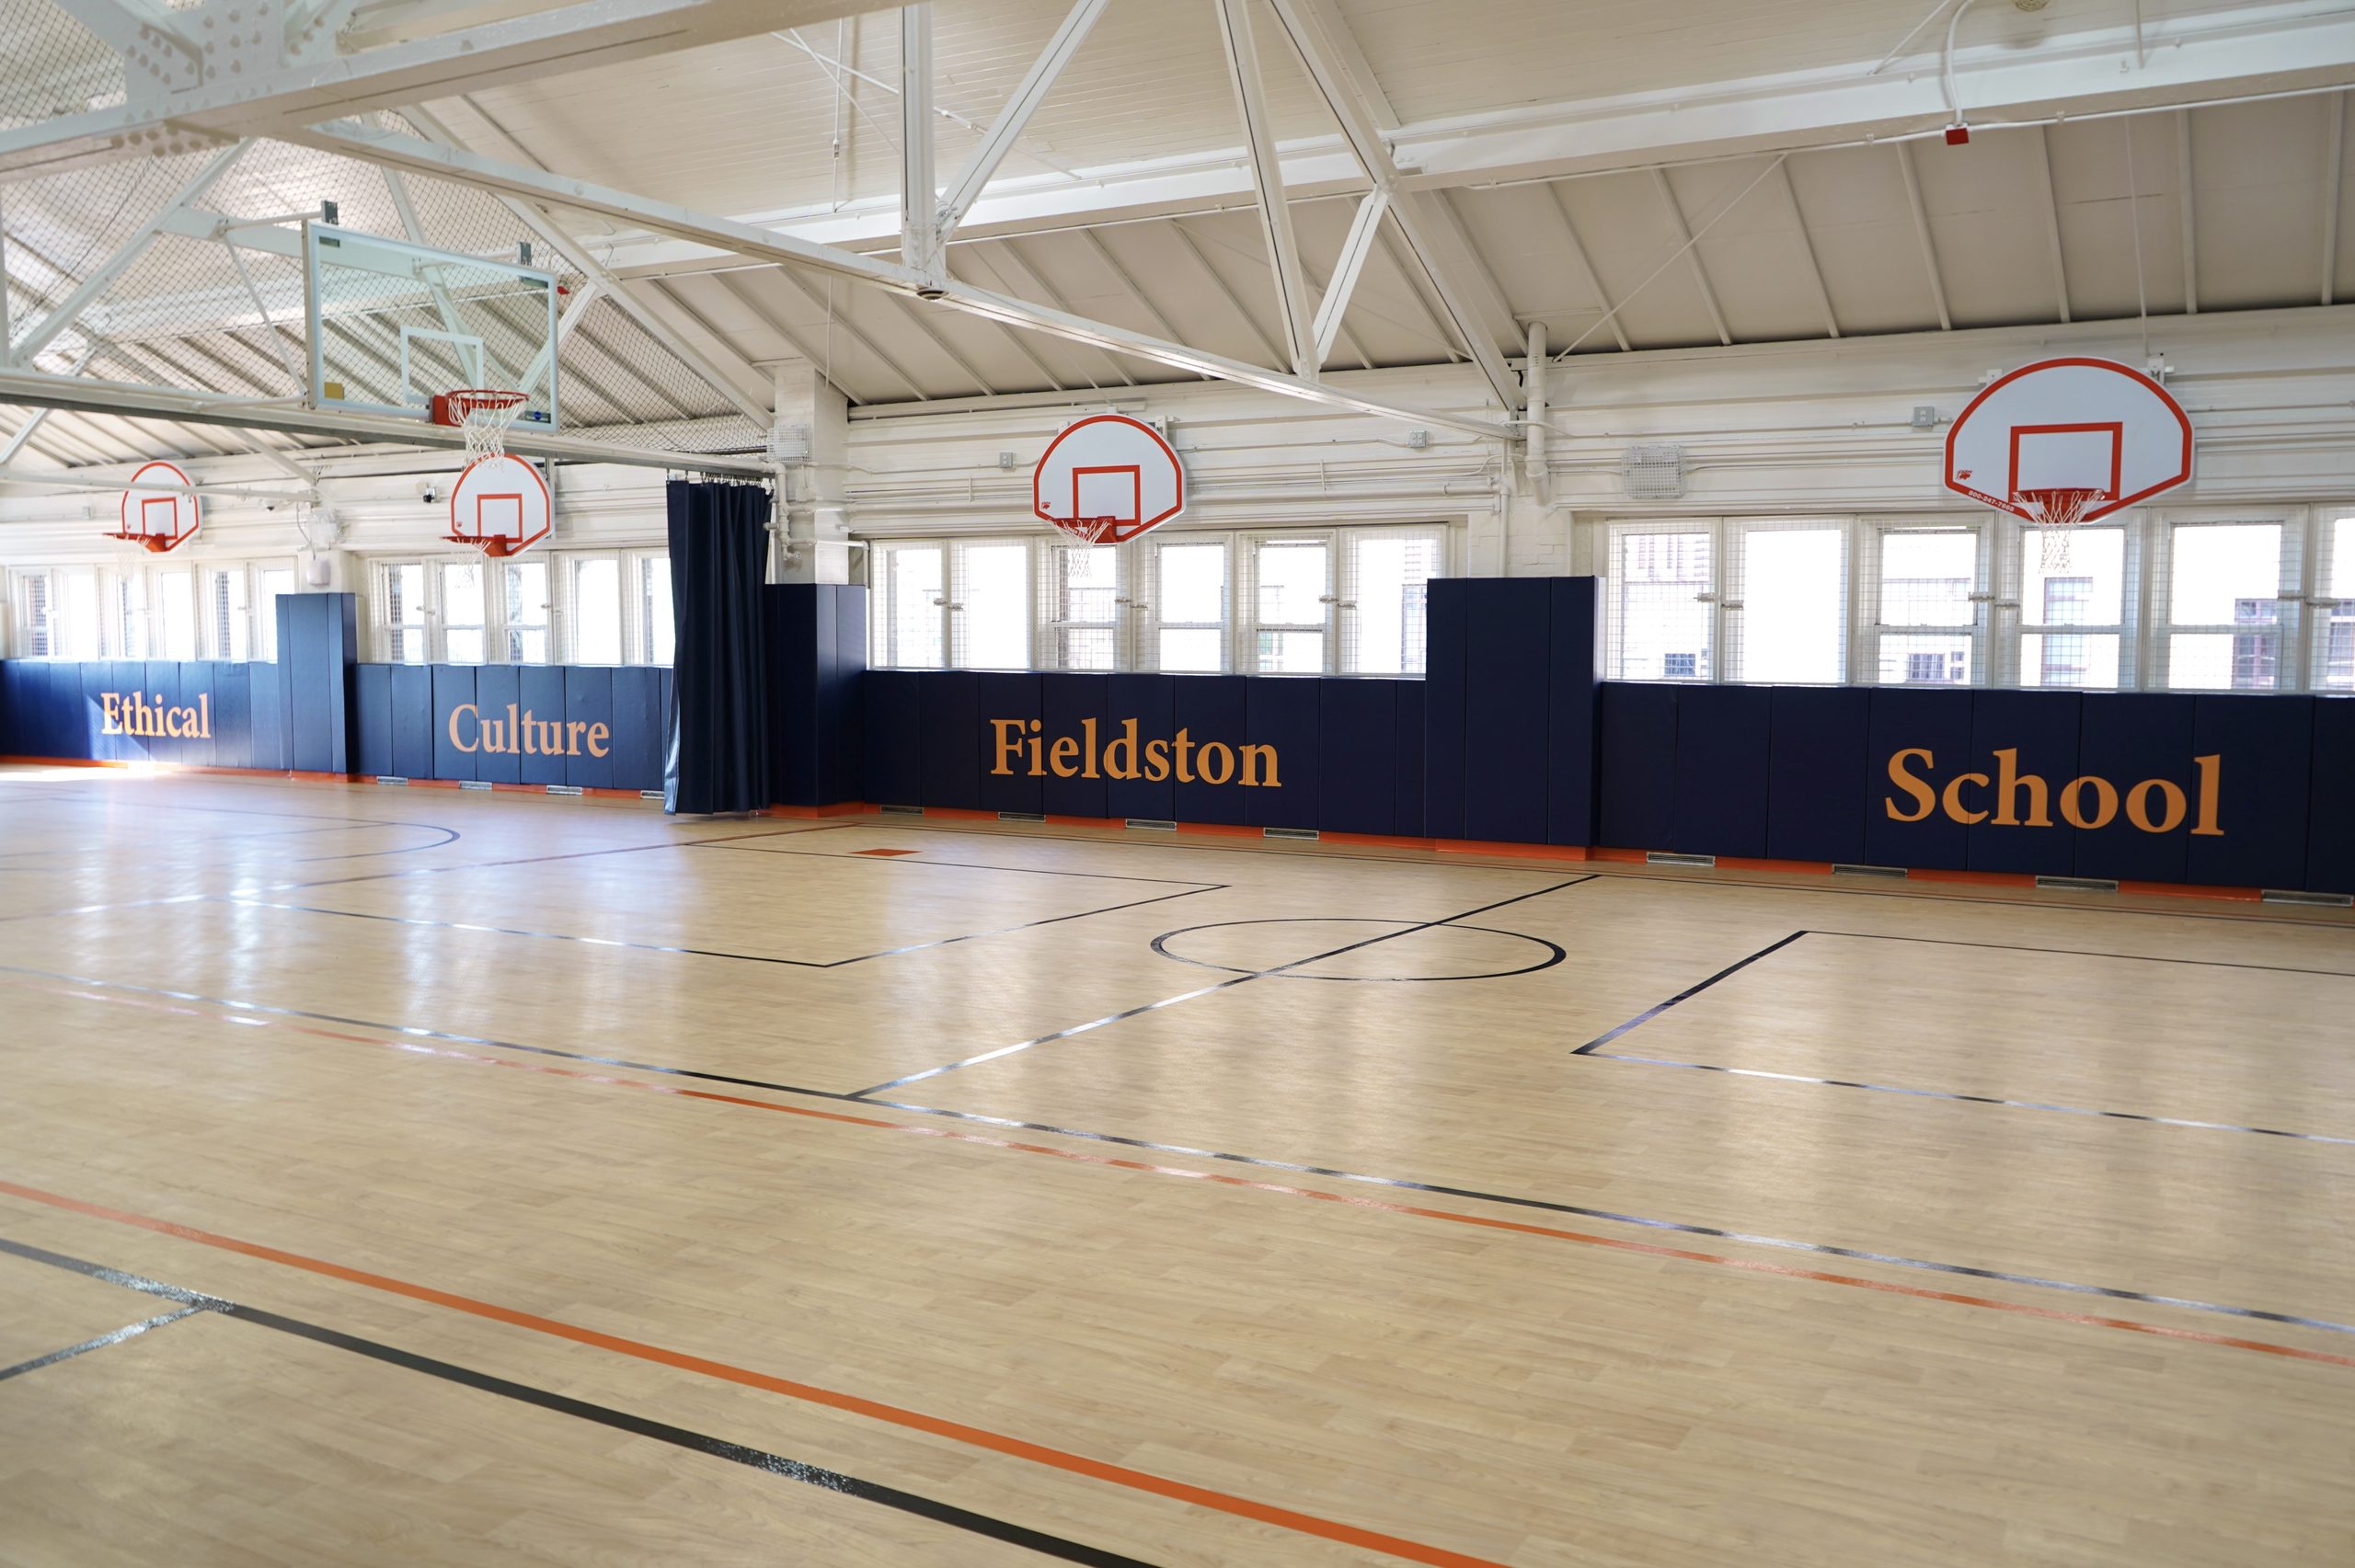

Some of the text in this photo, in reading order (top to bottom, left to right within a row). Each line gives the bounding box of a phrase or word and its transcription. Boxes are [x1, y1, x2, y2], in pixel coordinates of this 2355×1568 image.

[101, 692, 2224, 836] Ethical Culture Fieldston School
